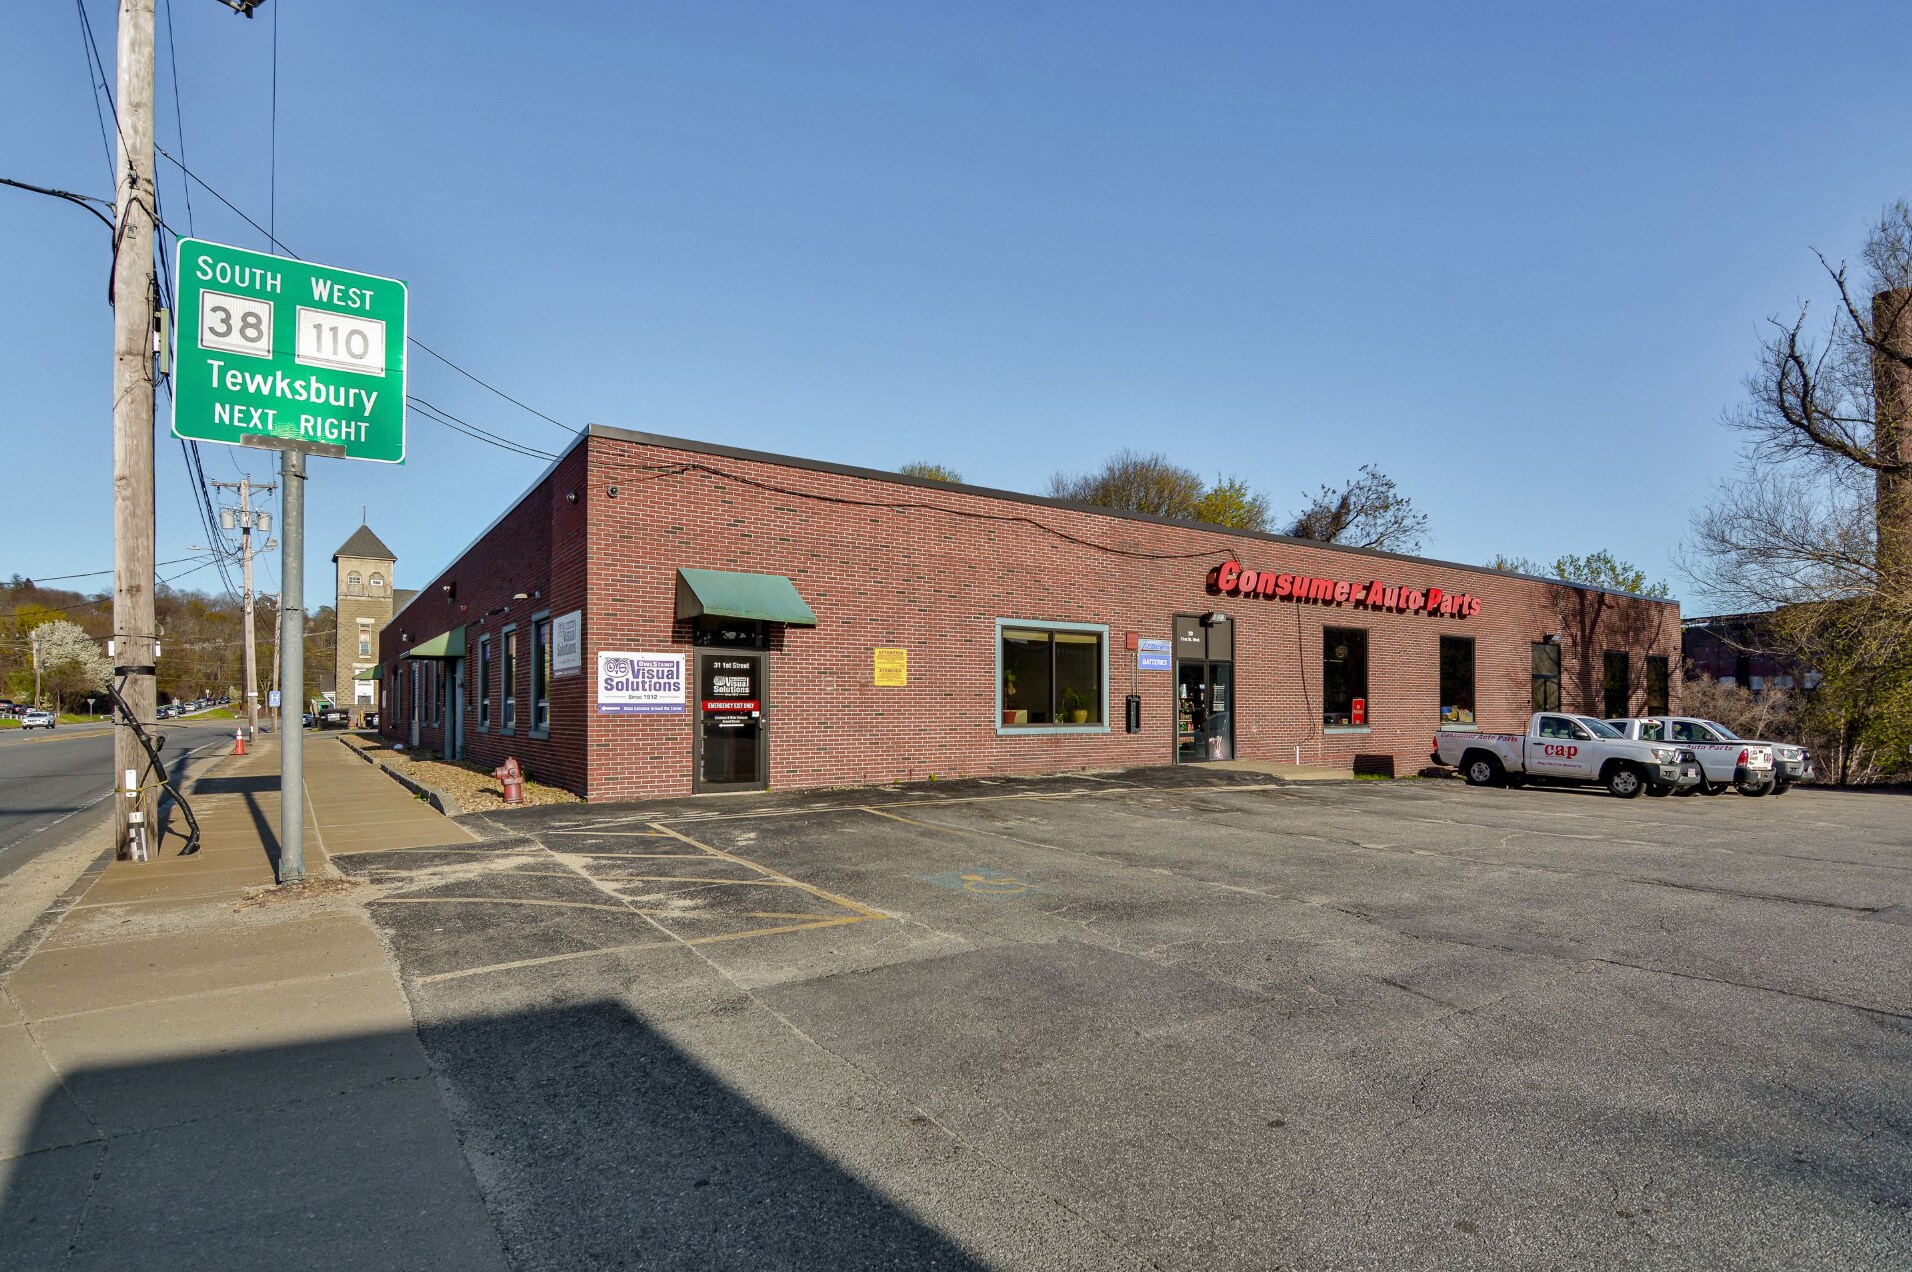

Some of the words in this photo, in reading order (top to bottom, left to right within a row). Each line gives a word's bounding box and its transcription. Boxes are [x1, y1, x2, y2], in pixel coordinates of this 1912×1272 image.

[196, 255, 282, 294] SOUTH
[310, 276, 374, 311] WEST
[207, 305, 264, 343] 38
[312, 322, 369, 360] 110
[207, 359, 378, 417] Tewksbury
[214, 402, 278, 431] NEXT
[300, 414, 369, 443] RIGHT
[1218, 560, 1364, 603] Consumer
[1366, 580, 1426, 610] Auto
[1426, 587, 1482, 616] Parts
[629, 659, 680, 680] Visual
[1142, 658, 1168, 666] BATTERIES
[604, 677, 681, 692] Solutions
[725, 677, 749, 687] Visual
[271, 693, 279, 702] H
[1440, 732, 1476, 740] Consumer
[1477, 733, 1496, 741] Auto
[1497, 735, 1518, 743] Parts
